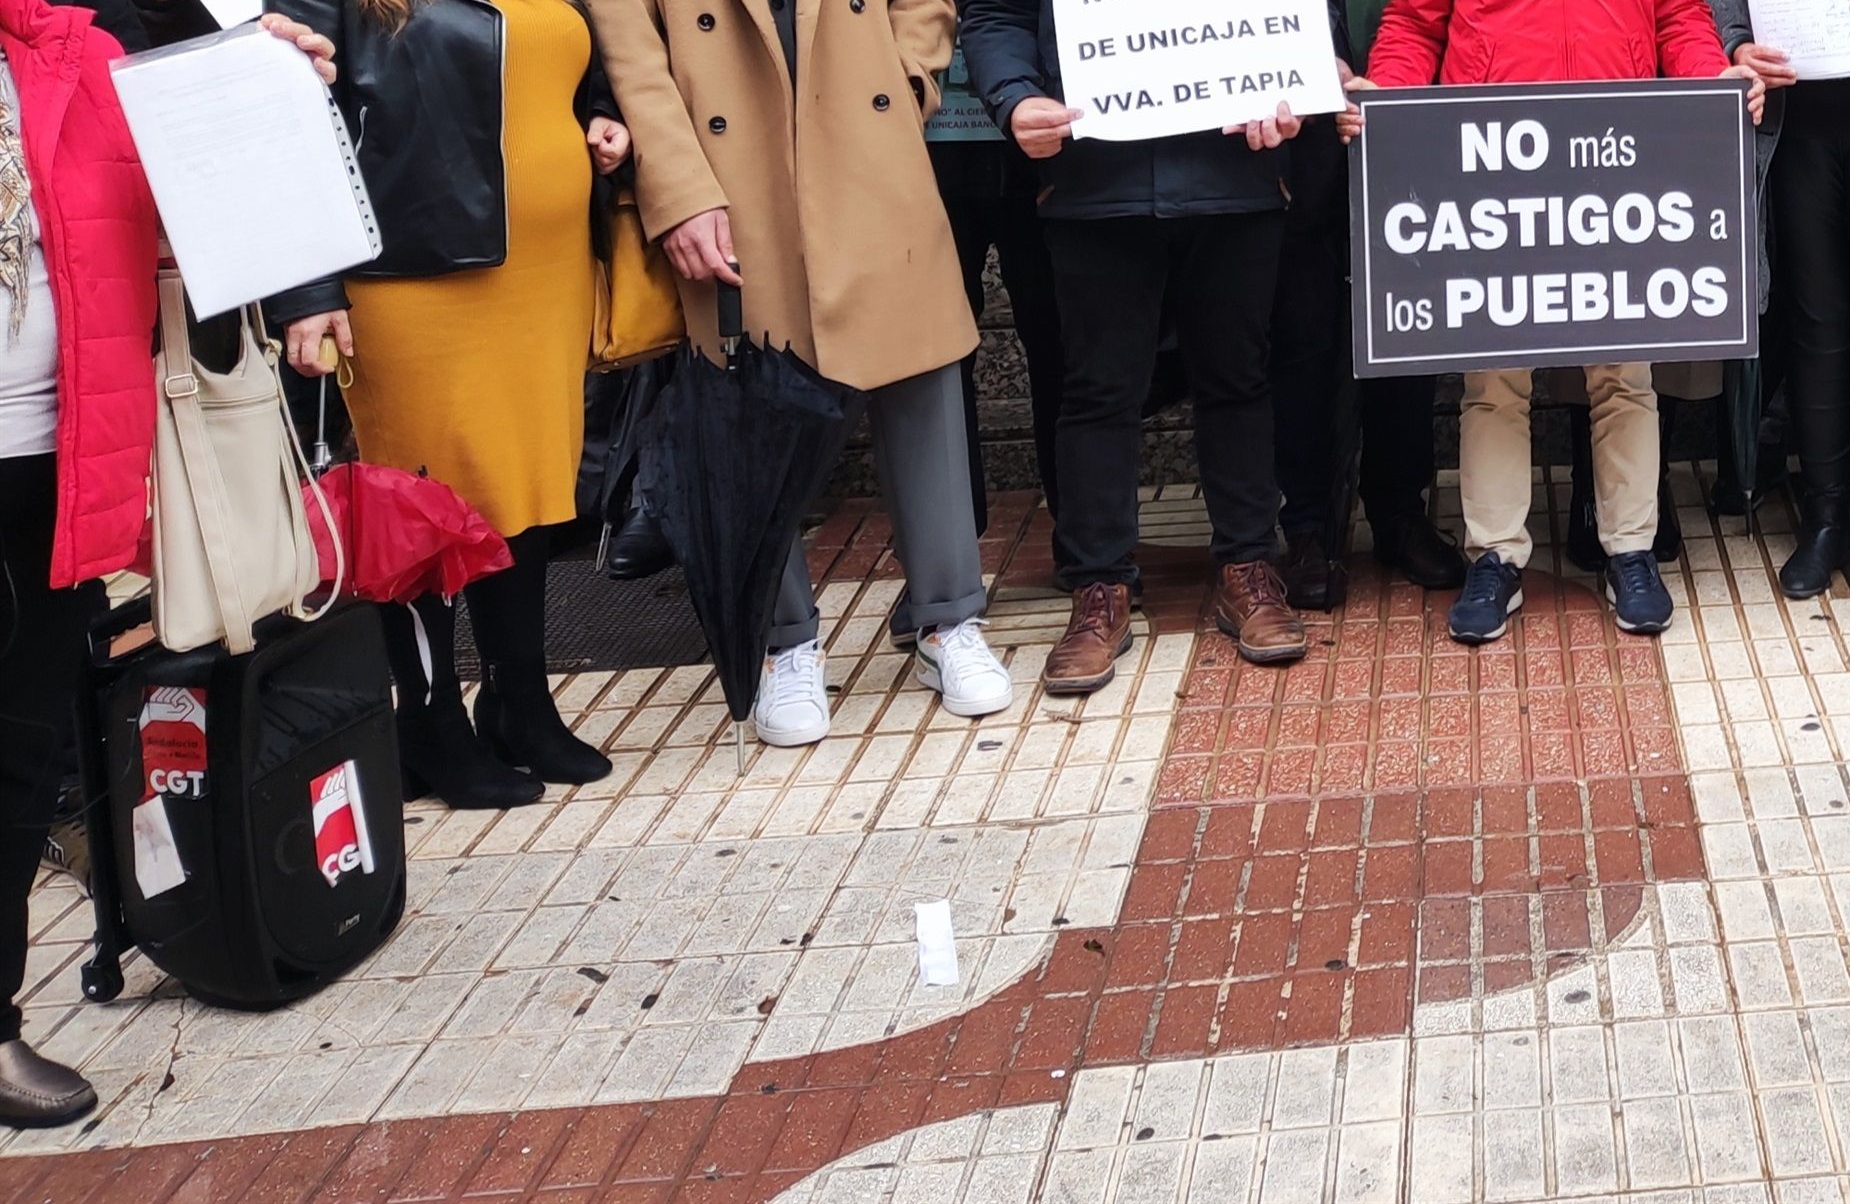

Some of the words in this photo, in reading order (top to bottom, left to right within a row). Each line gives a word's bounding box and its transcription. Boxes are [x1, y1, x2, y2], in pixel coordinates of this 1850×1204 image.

[1079, 38, 1116, 61] DE
[1127, 19, 1255, 52] UNICAJA
[1264, 15, 1301, 35] EN
[954, 107, 965, 115] AL
[1092, 90, 1163, 115] VVA.
[1173, 81, 1211, 104] DE
[1219, 69, 1305, 94] TAPIA
[932, 121, 968, 129] UNICAJA
[1460, 120, 1549, 172] NO
[1570, 128, 1636, 168] más
[1384, 191, 1694, 254] CASTIGOS
[1710, 208, 1728, 239] a
[1386, 292, 1433, 332] los
[1445, 267, 1728, 329] PUEBLOS
[150, 769, 204, 797] CGT
